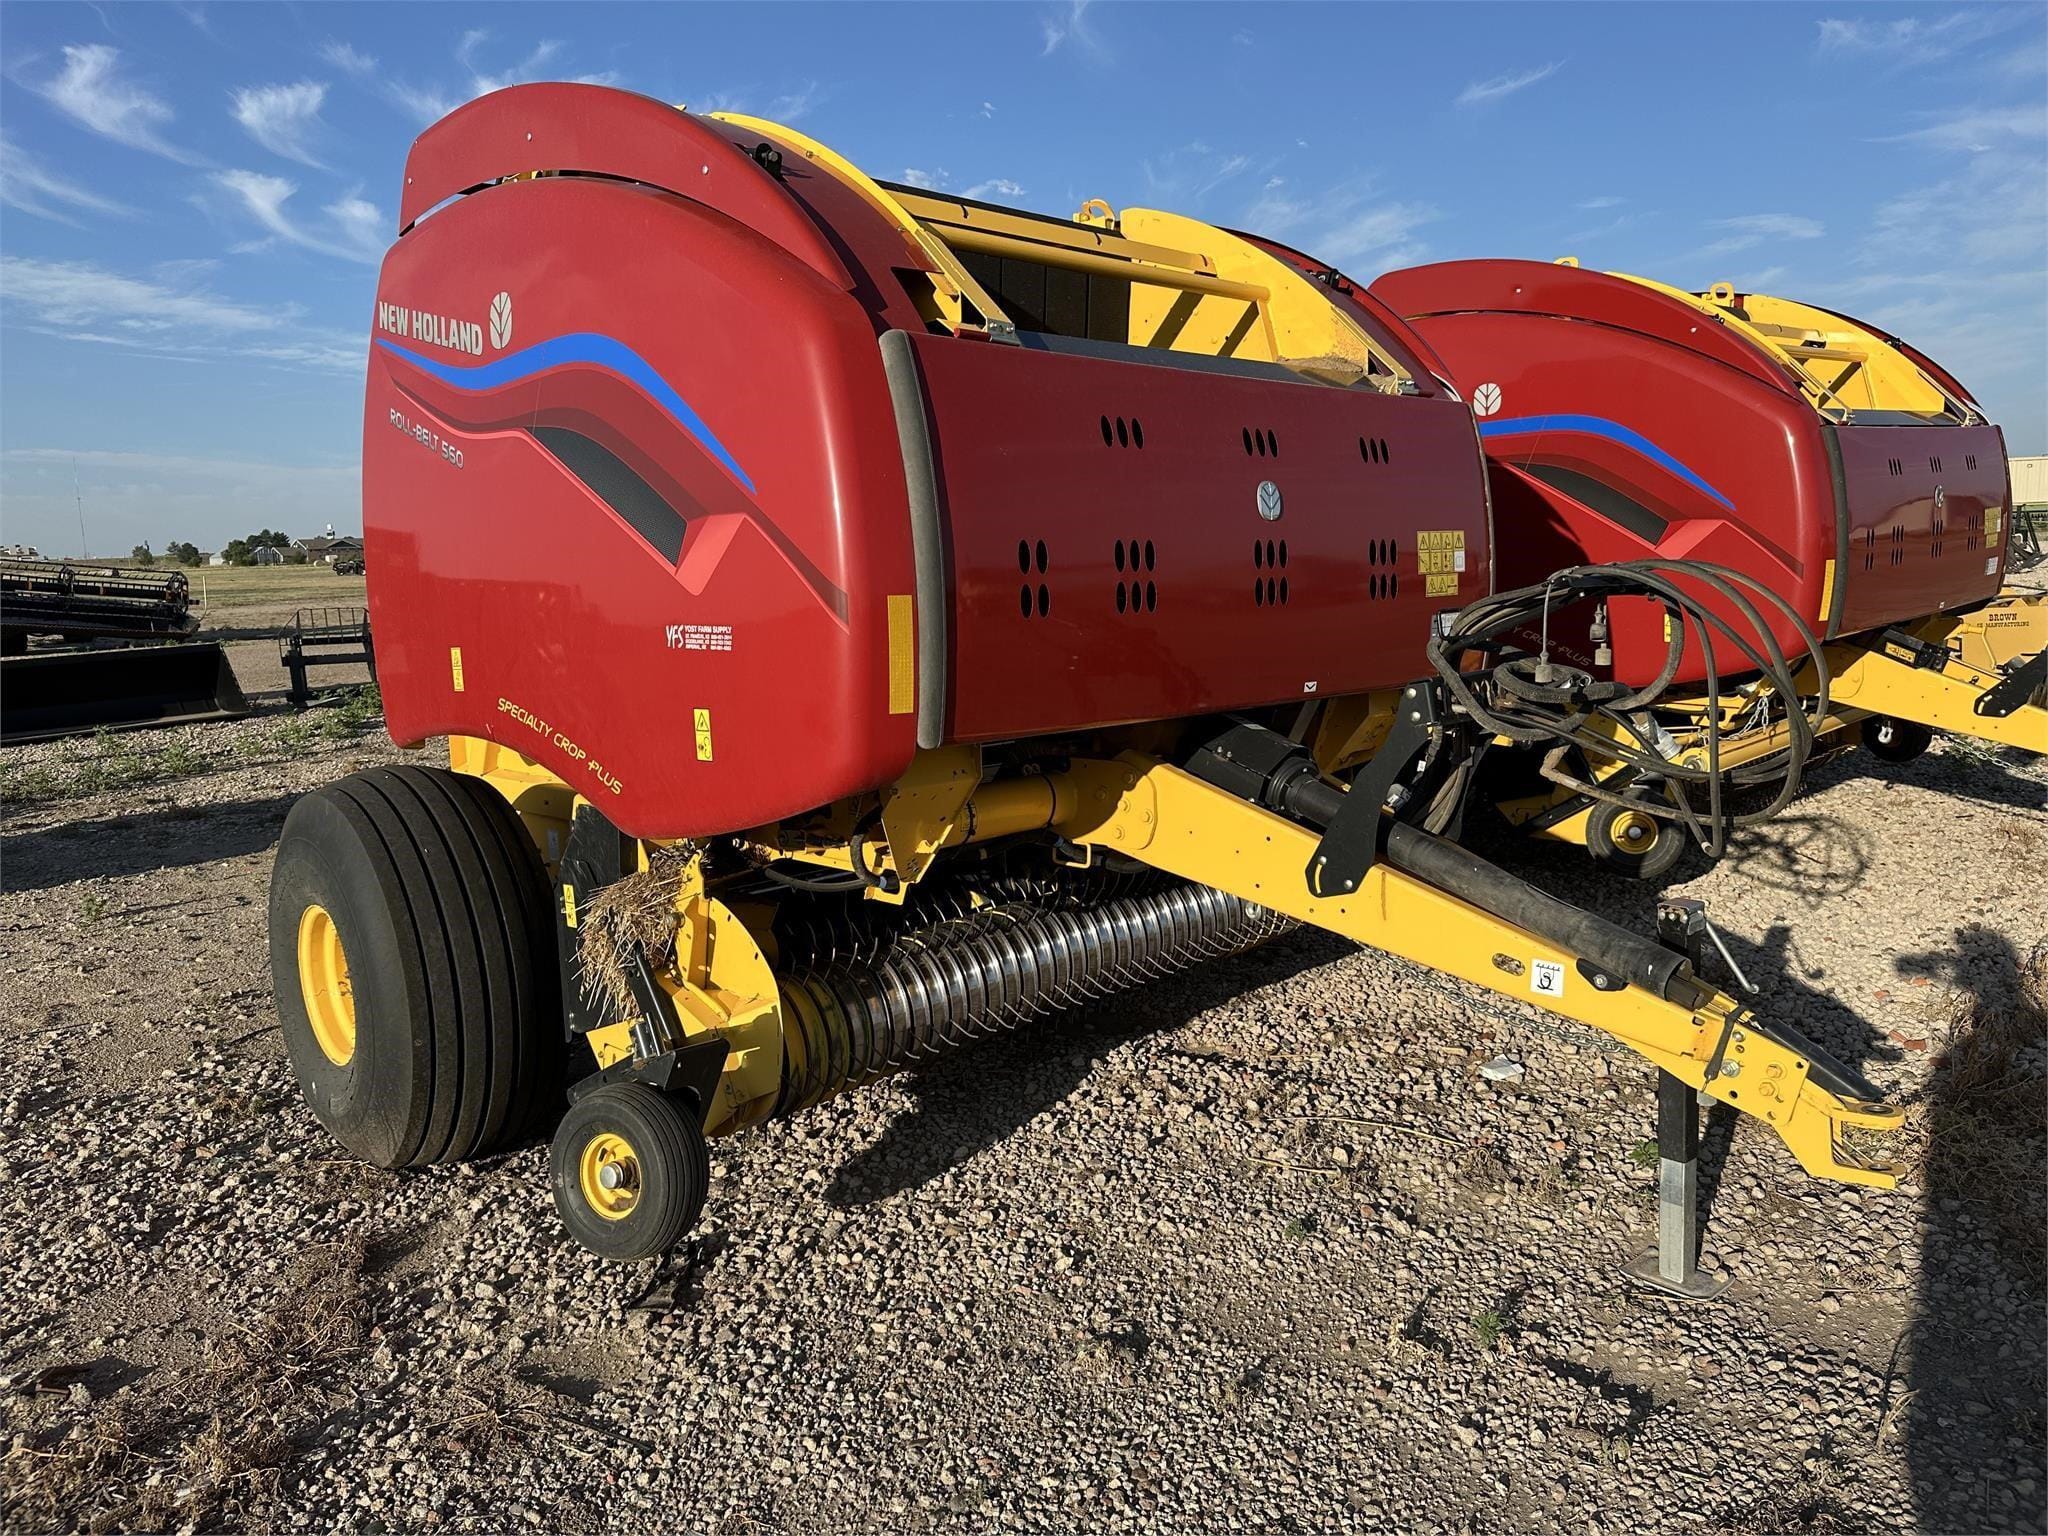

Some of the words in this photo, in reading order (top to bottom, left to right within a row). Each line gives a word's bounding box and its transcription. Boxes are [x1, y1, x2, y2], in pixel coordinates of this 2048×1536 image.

[379, 301, 409, 338] NEW
[412, 309, 484, 357] HOLLAND
[390, 407, 440, 453] ROLL-BELT
[684, 625, 698, 633] YOST
[697, 625, 712, 634] FARM
[712, 625, 732, 634] SUPPLY
[1988, 613, 2018, 622] BROWN
[665, 624, 684, 649] YFS
[497, 697, 554, 738] SPECIALTY
[553, 732, 587, 762] CROP
